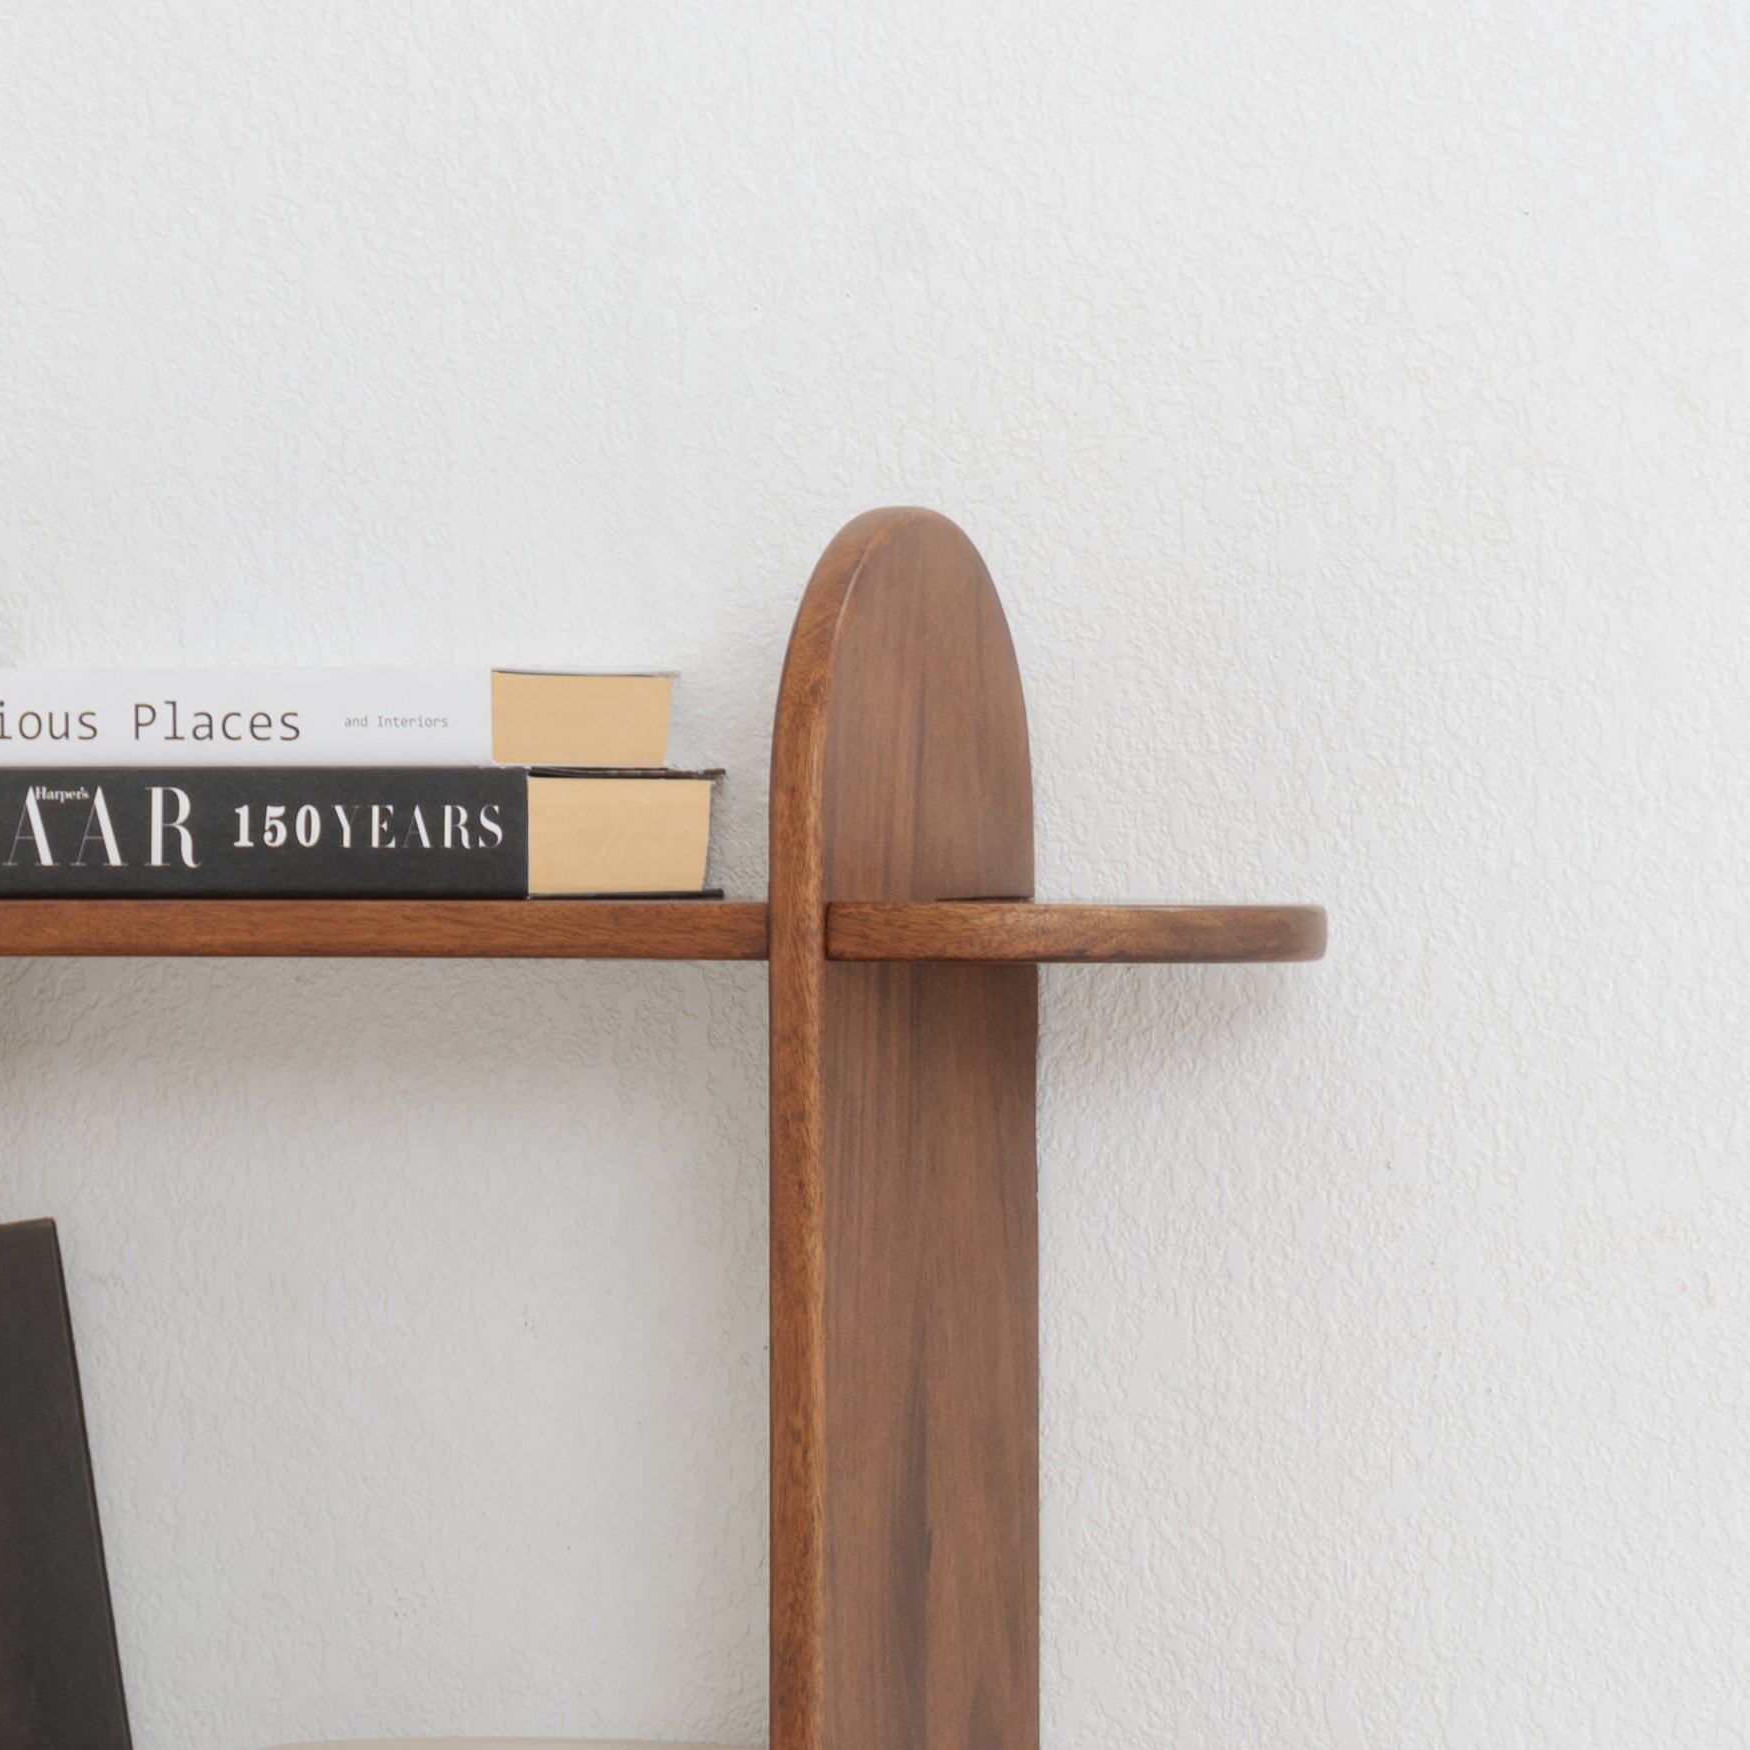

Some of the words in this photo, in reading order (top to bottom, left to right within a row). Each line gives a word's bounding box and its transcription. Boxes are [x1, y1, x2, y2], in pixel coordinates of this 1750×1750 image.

[134, 700, 300, 741] Places
[344, 714, 368, 728] and
[377, 714, 449, 728] Interiors
[35, 786, 89, 803] Harper's
